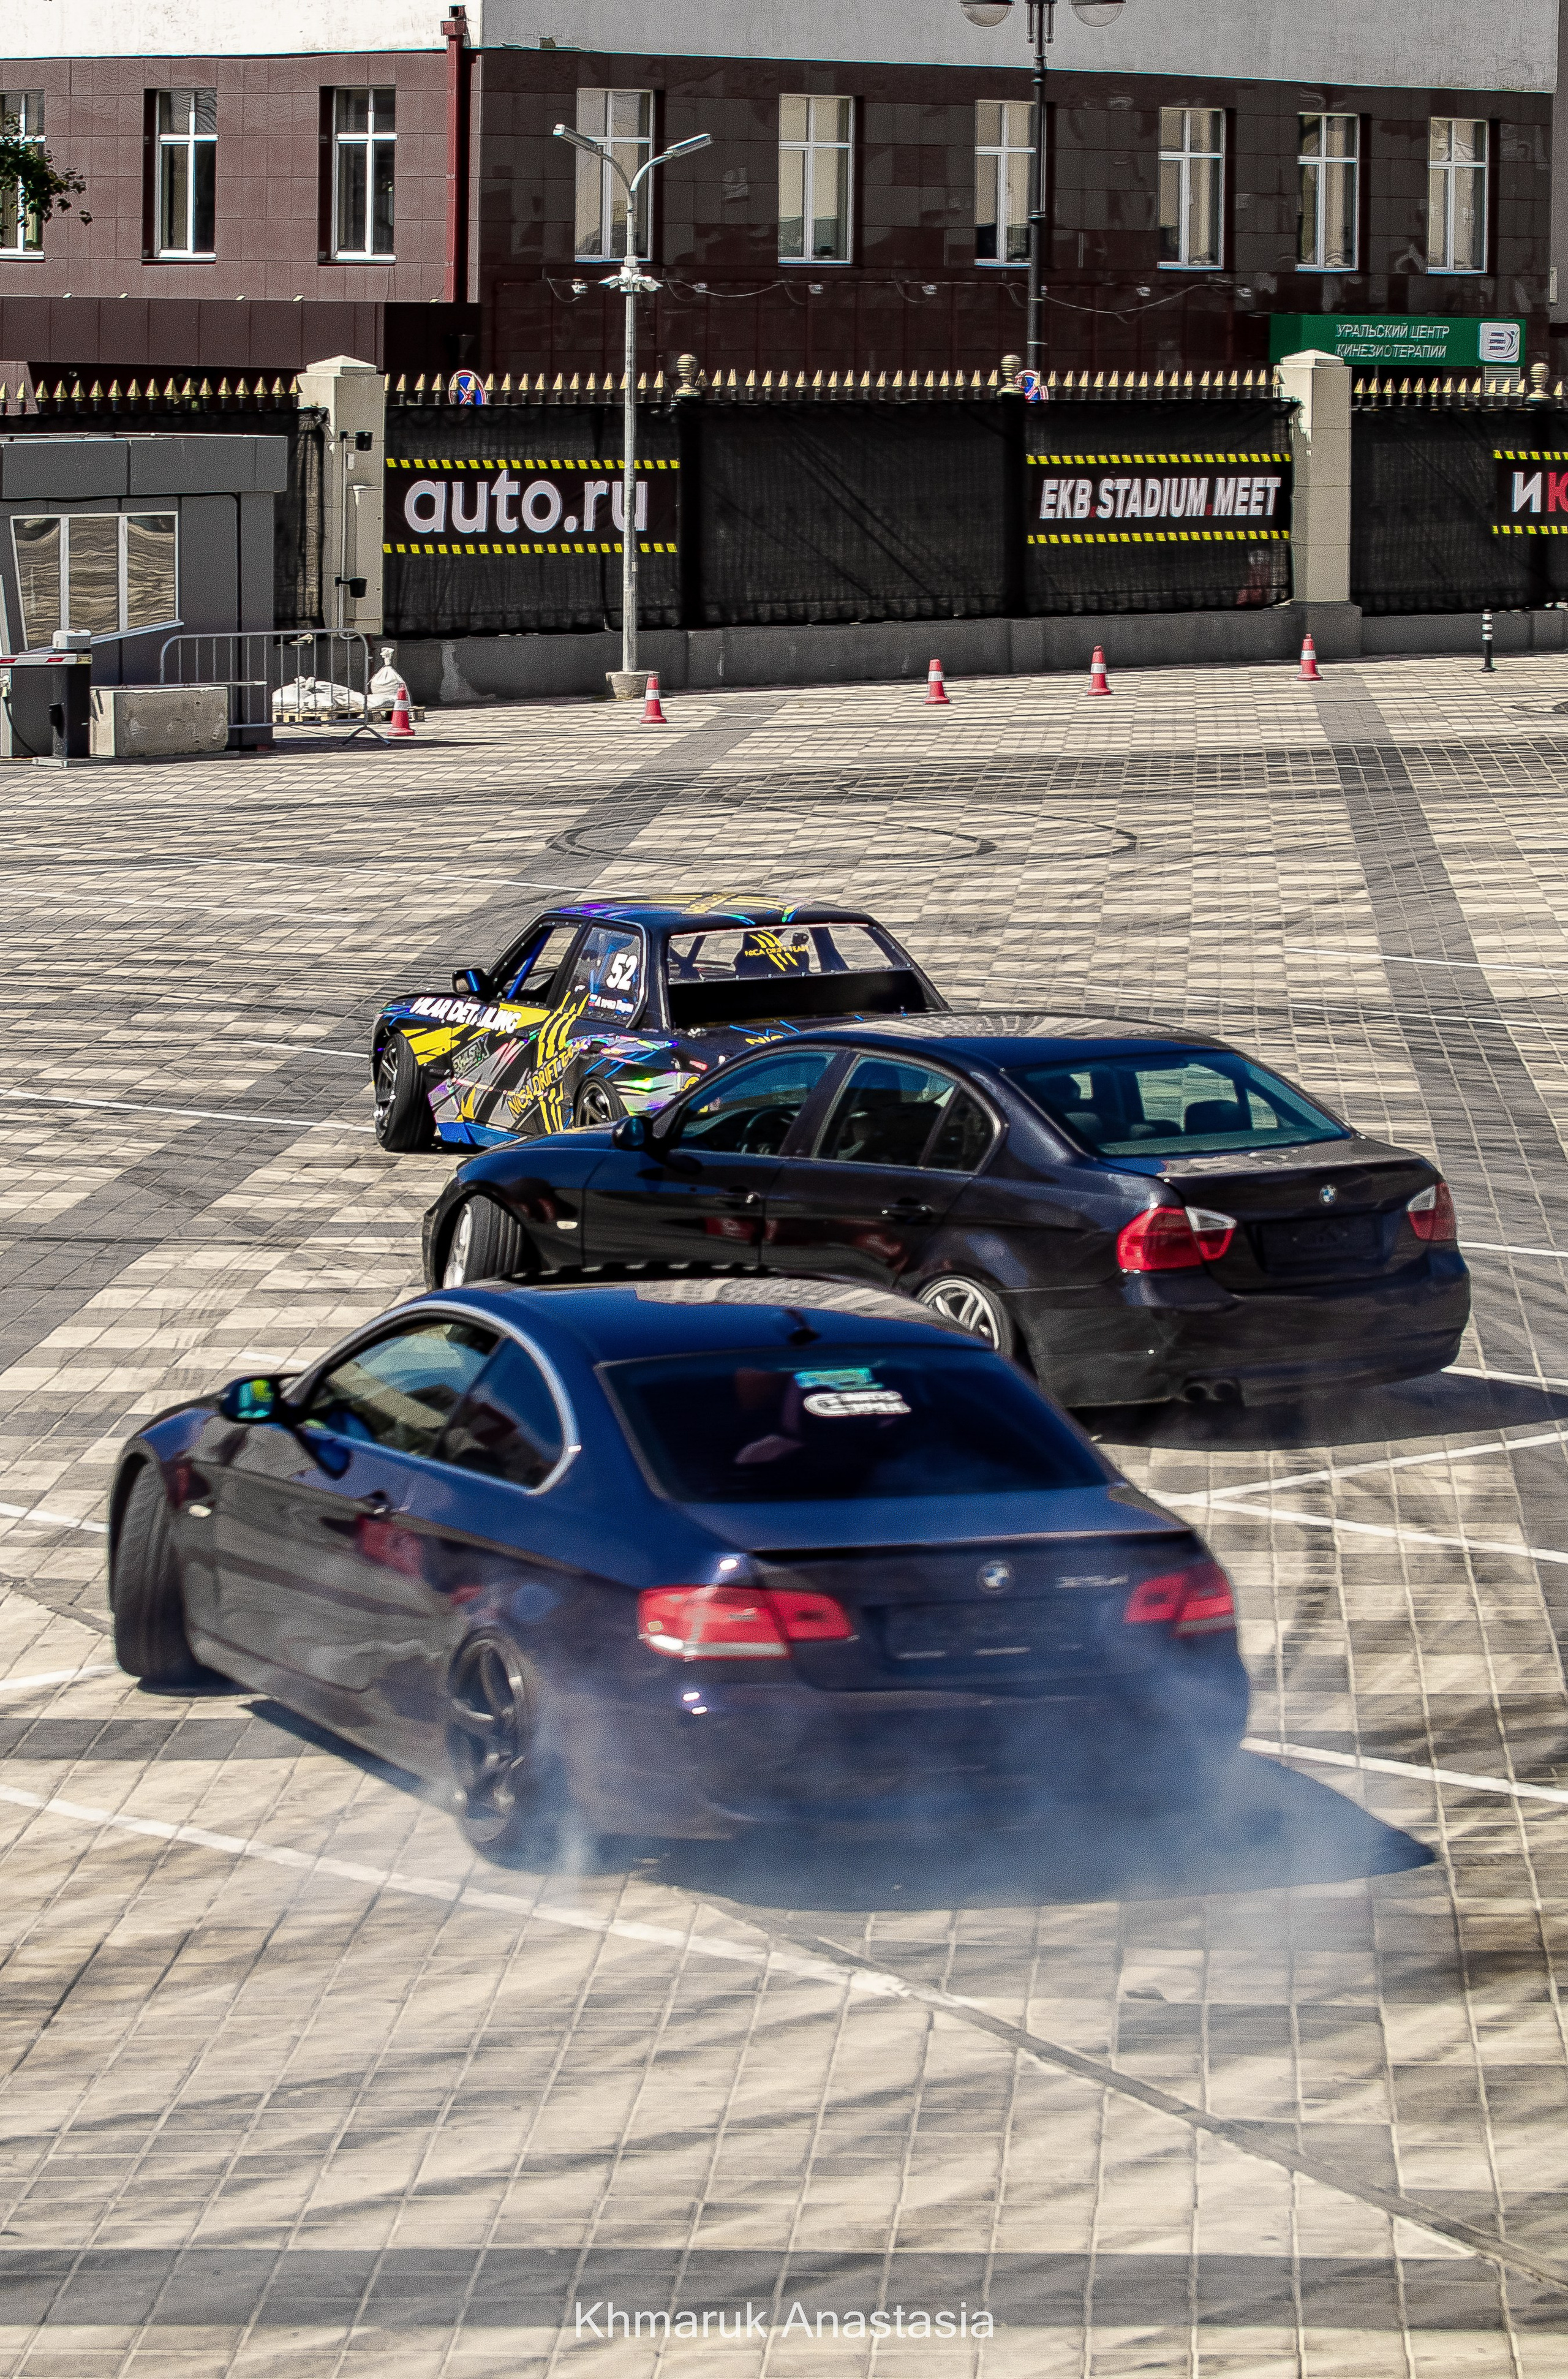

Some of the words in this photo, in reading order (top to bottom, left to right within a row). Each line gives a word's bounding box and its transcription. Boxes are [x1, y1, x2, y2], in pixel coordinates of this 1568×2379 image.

[1335, 322, 1408, 338] УРАЛЬСКИЙ
[1409, 325, 1450, 342] ЦЕНТР
[1335, 344, 1447, 358] КИНЕЗИОТЕРАПИИ
[404, 469, 648, 533] auto.ru
[606, 953, 638, 991] 52
[446, 1000, 522, 1034] DETAILING
[532, 1057, 559, 1096] DRIFT
